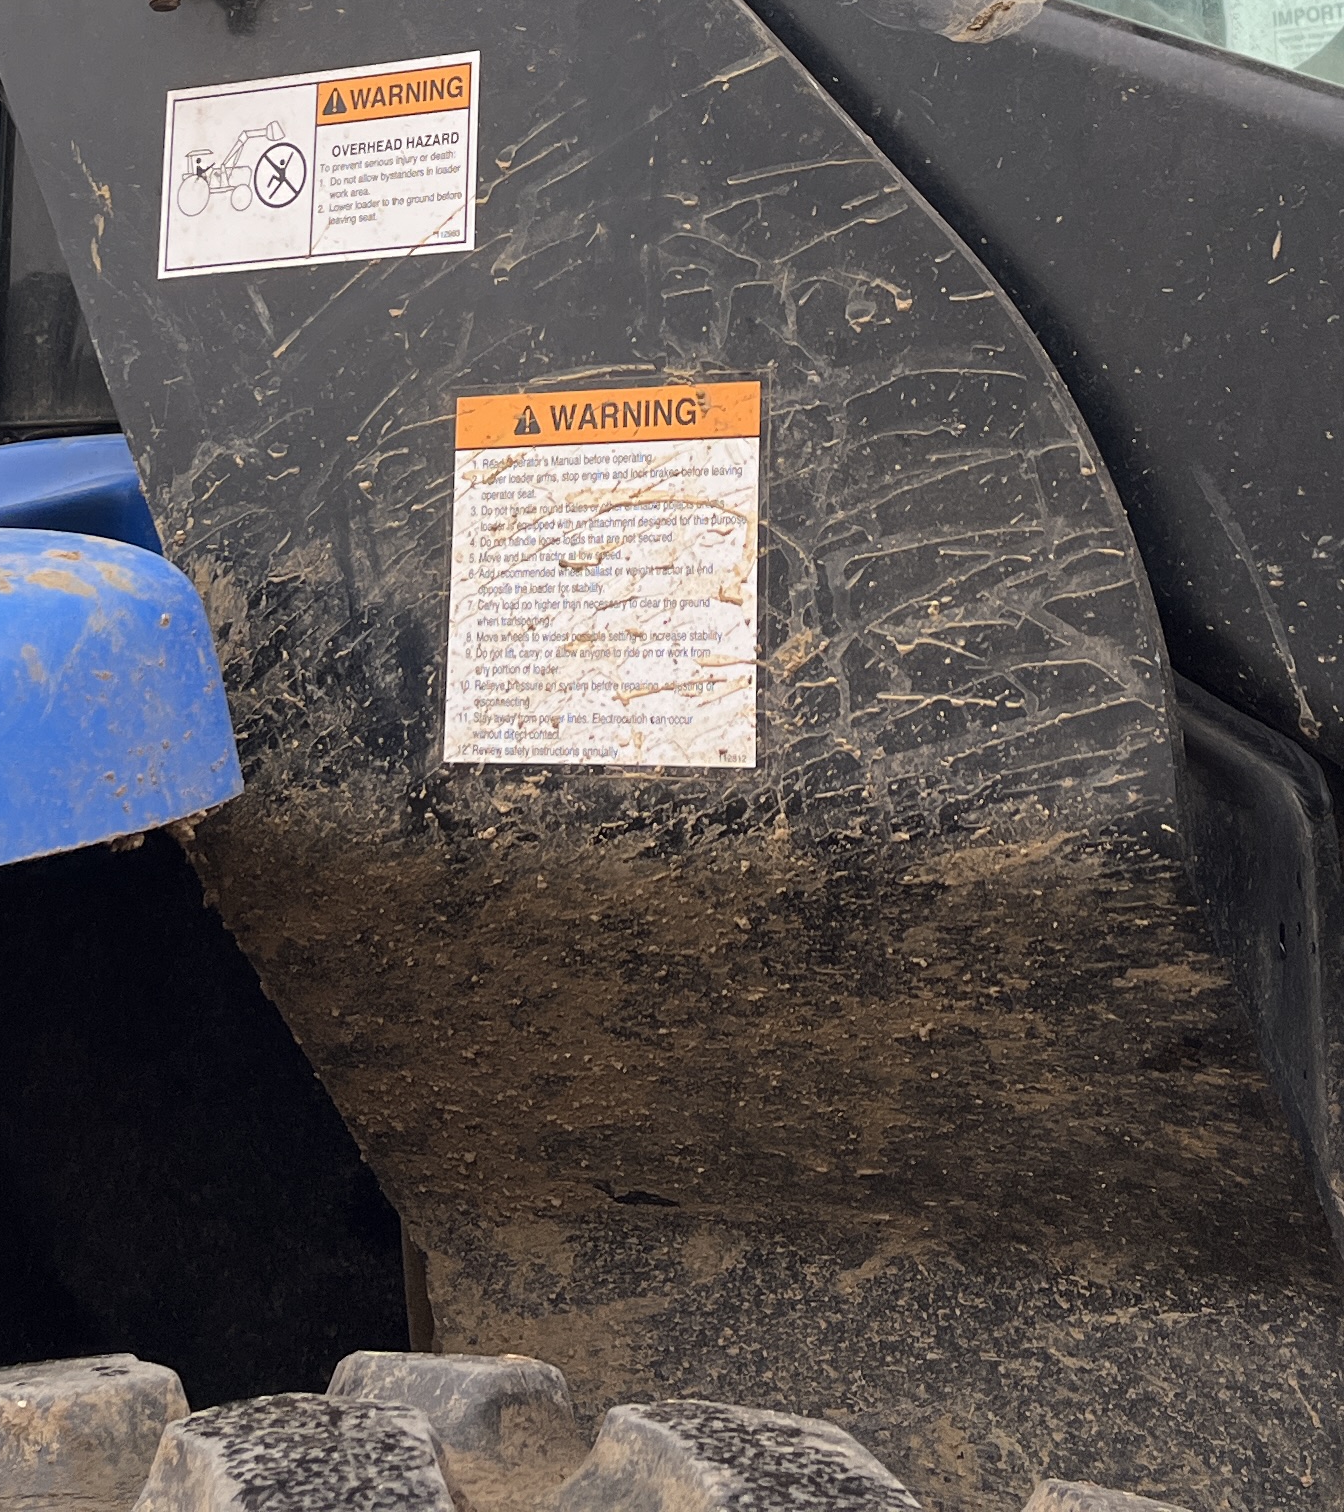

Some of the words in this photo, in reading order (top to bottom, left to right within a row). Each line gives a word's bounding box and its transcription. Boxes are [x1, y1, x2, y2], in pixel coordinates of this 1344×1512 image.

[350, 76, 463, 109] WARNING
[332, 139, 402, 157] OVERHEAD
[406, 131, 460, 149] HAZARD
[332, 160, 362, 173] prevent
[364, 157, 394, 168] serious
[396, 154, 418, 167] injury
[358, 172, 379, 183] allow
[381, 168, 424, 182] bystanders
[436, 164, 461, 175] loader
[330, 189, 348, 199] work
[329, 201, 353, 213] Lower
[355, 199, 381, 210] loader
[392, 195, 405, 206] the
[407, 192, 435, 207] ground
[437, 190, 462, 202] before
[329, 215, 357, 227] leaving
[550, 398, 697, 432] WARNING
[551, 455, 582, 467] Manual
[584, 453, 608, 465] before
[509, 472, 534, 484] loader
[561, 471, 579, 484] stop
[582, 469, 609, 484] engine
[612, 468, 628, 480] and
[630, 468, 647, 479] lock
[711, 465, 743, 478] leaving
[481, 490, 515, 502] operator
[495, 505, 508, 516] not
[539, 503, 563, 514] round
[588, 533, 604, 544] that
[479, 552, 502, 563] Move
[504, 551, 519, 562] and
[539, 550, 566, 562] tractor
[478, 567, 495, 579] Add
[535, 598, 560, 612] higher
[476, 631, 499, 643] Move
[650, 629, 687, 641] increase
[475, 647, 488, 659] Do
[579, 647, 611, 661] anyone
[667, 646, 688, 658] work
[690, 645, 711, 658] from
[492, 664, 521, 677] portion
[668, 715, 694, 725] occur
